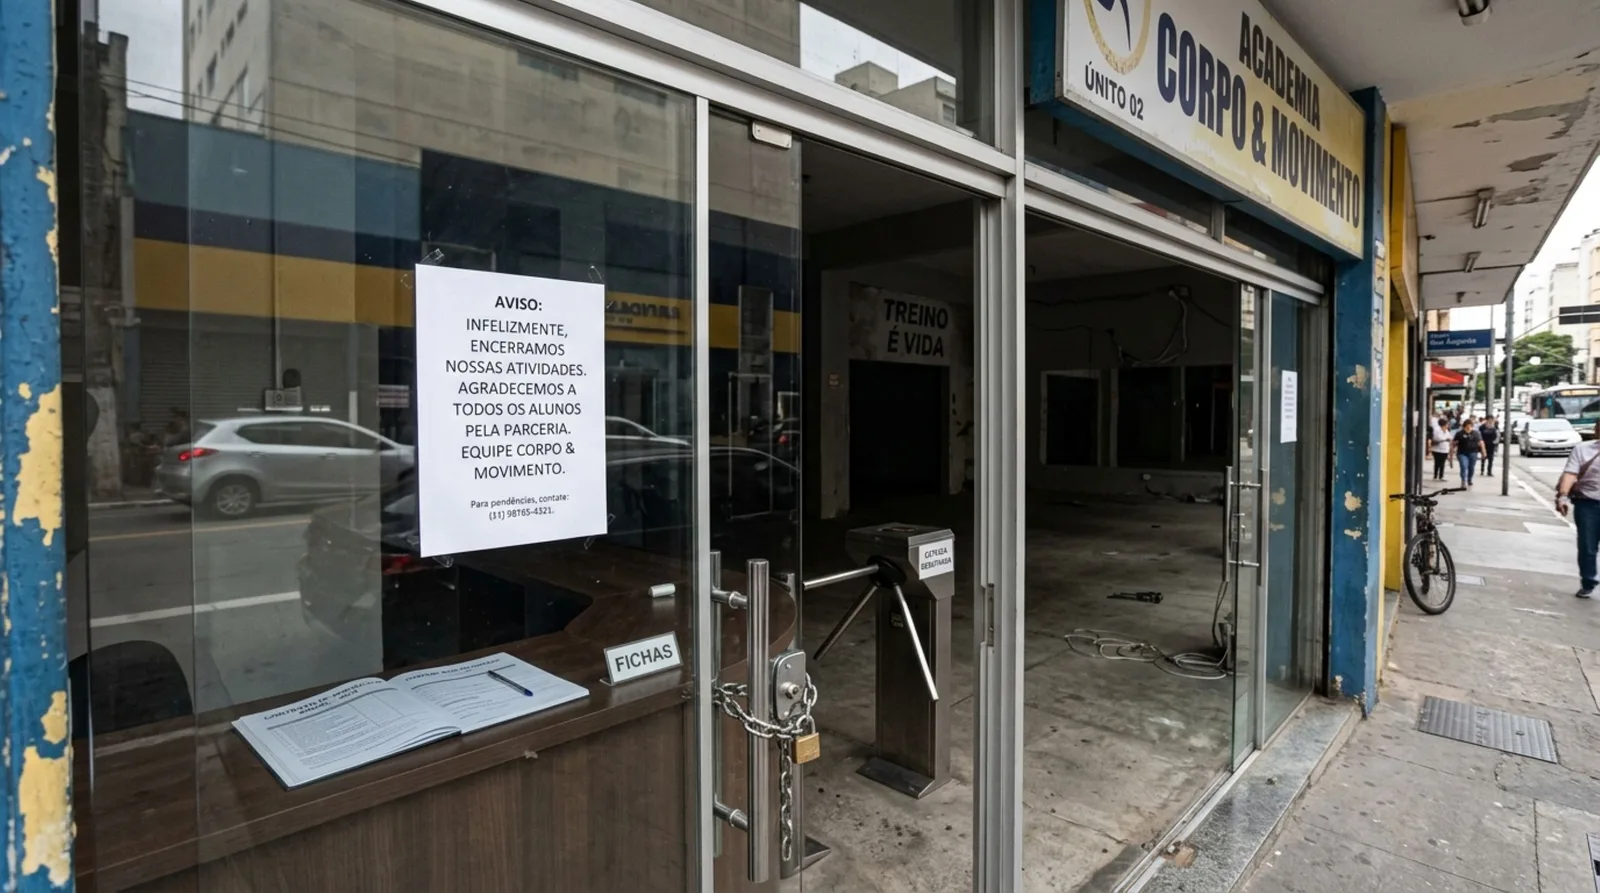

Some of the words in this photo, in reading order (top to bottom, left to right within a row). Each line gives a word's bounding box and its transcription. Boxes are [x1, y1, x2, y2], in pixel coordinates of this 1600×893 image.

[1239, 11, 1320, 131] ACADEMIA
[1085, 61, 1126, 109] ÚNITO
[1130, 93, 1144, 121] 02
[1157, 12, 1247, 151] CORPO
[1252, 101, 1266, 167] &
[1272, 105, 1360, 229] MOVIMENTO
[495, 295, 542, 311] AVISO:
[884, 298, 949, 329] TREINO
[466, 318, 568, 338] INFELIZMENTE,
[470, 339, 565, 356] ENCERRAMOS
[887, 325, 899, 353] É
[904, 331, 944, 358] VIDA
[445, 360, 502, 374] NOSSAS
[506, 362, 587, 376] ATIVIDADES.
[458, 381, 564, 396] AGRADECEMOS
[567, 383, 577, 395] A
[453, 402, 503, 416] TODOS
[507, 402, 525, 416] OS
[529, 402, 581, 416] ALUNOS
[466, 424, 500, 437] PELA
[504, 422, 571, 436] PARCERIA.
[461, 444, 512, 460] EQUIPE
[517, 442, 562, 456] CORPO
[565, 441, 575, 454] &
[474, 462, 566, 480] MOVIMENTO.
[470, 499, 488, 509] Para
[539, 493, 570, 504] contate:
[615, 644, 673, 672] FICHAS
